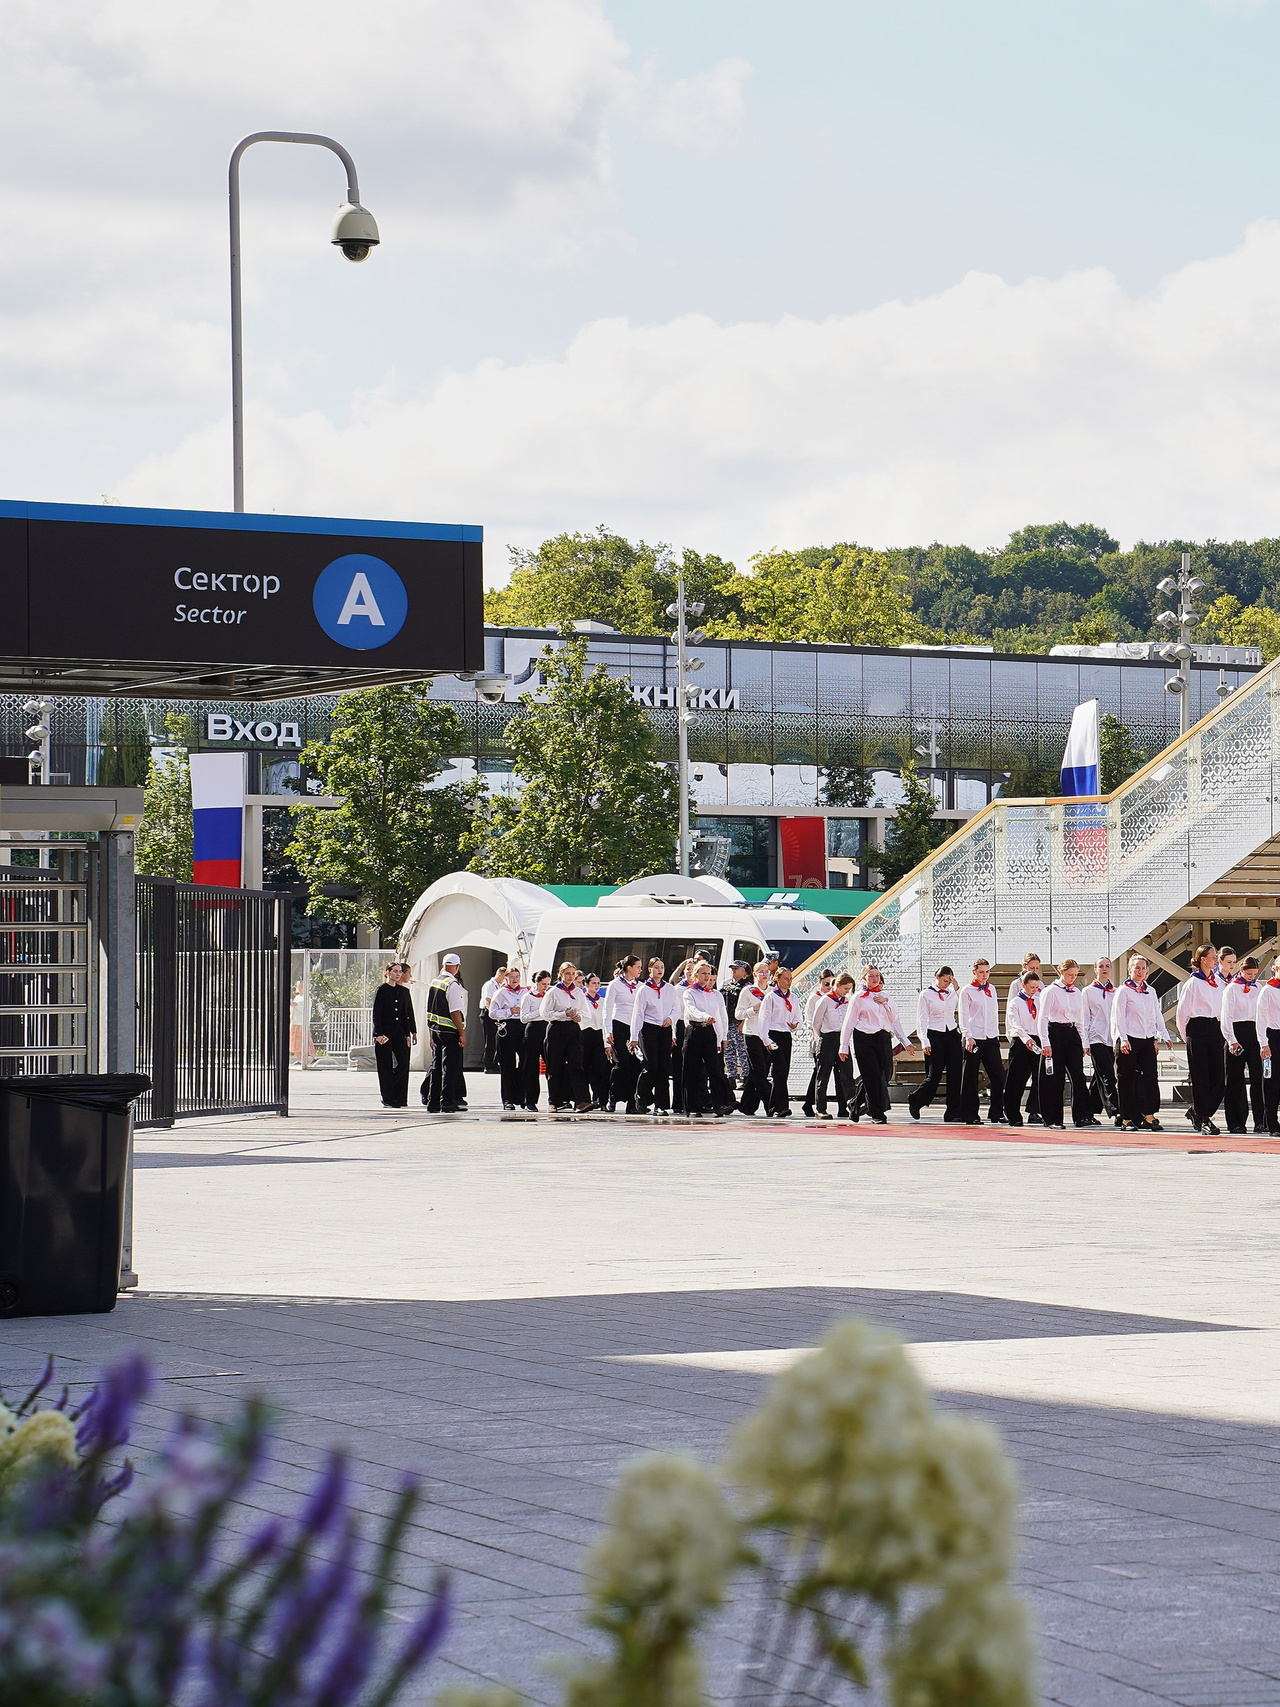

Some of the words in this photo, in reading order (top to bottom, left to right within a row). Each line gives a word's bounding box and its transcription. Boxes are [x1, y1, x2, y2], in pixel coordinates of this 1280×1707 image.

[174, 567, 281, 599] Сектор
[173, 604, 247, 625] Sector
[207, 713, 302, 747] Вход
